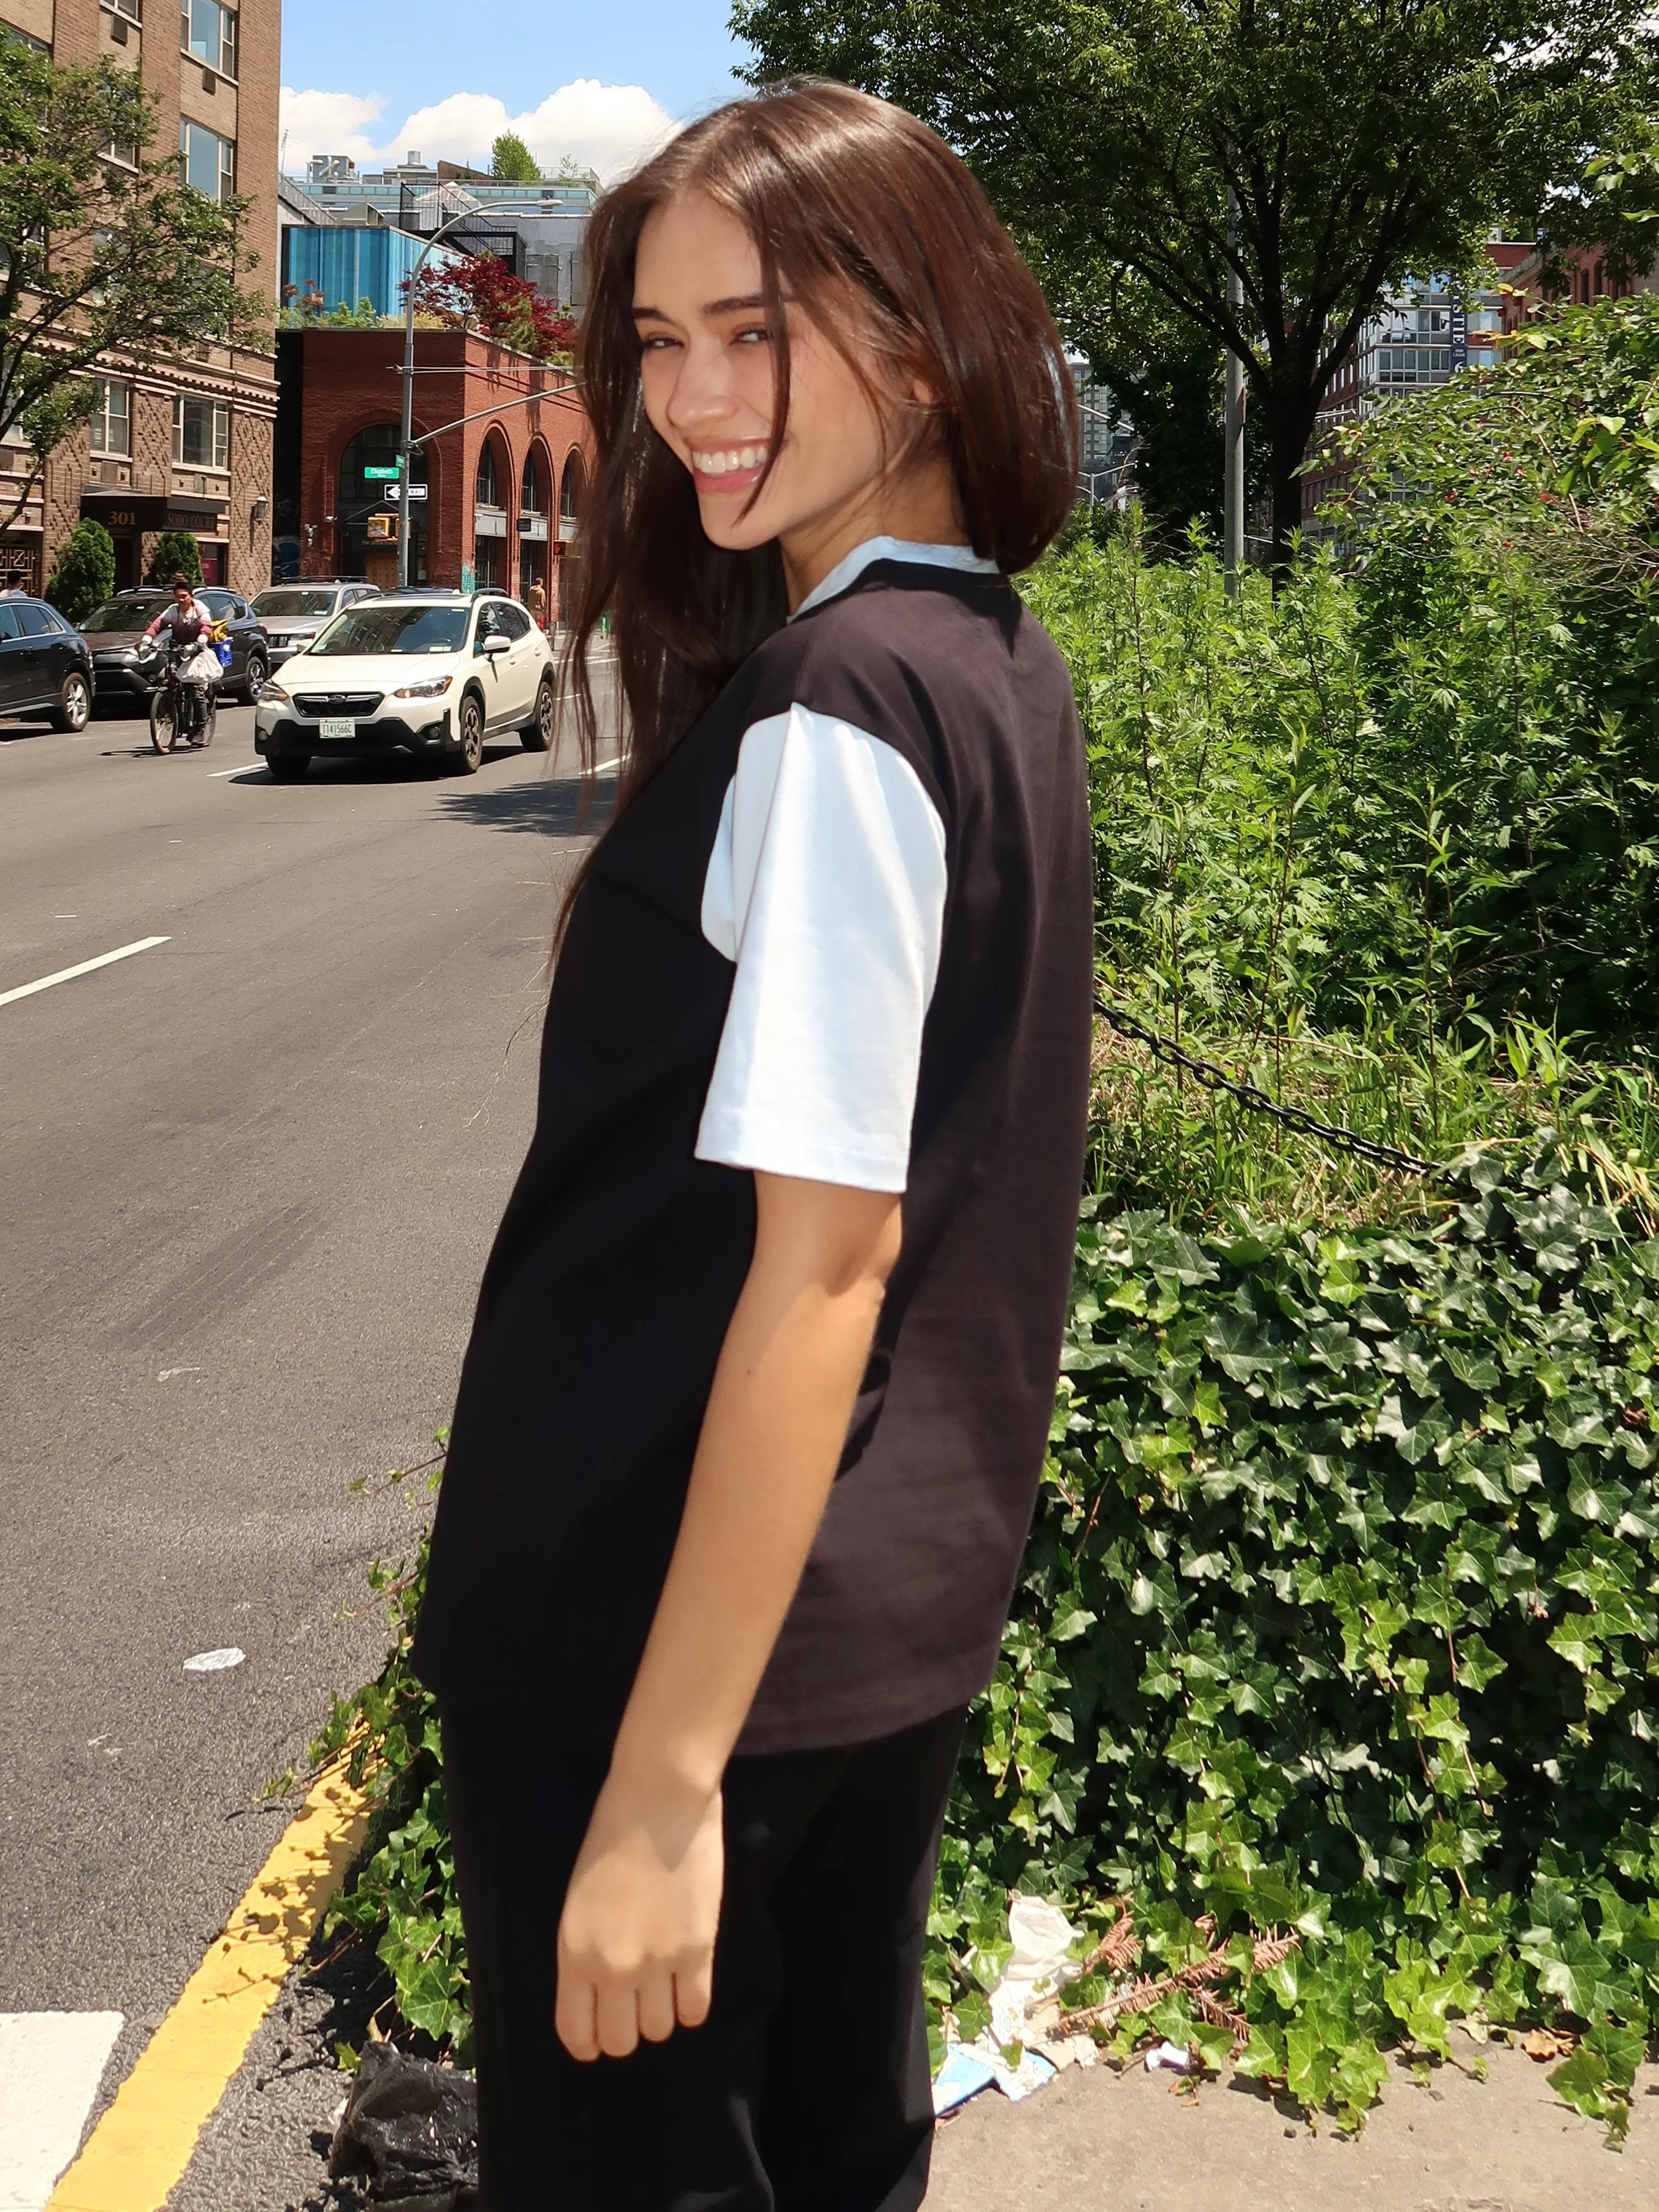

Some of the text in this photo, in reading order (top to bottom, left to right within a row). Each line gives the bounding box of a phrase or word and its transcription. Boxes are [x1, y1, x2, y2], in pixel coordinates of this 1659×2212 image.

[108, 511, 136, 525] 301
[167, 513, 215, 529] SOHO COURT
